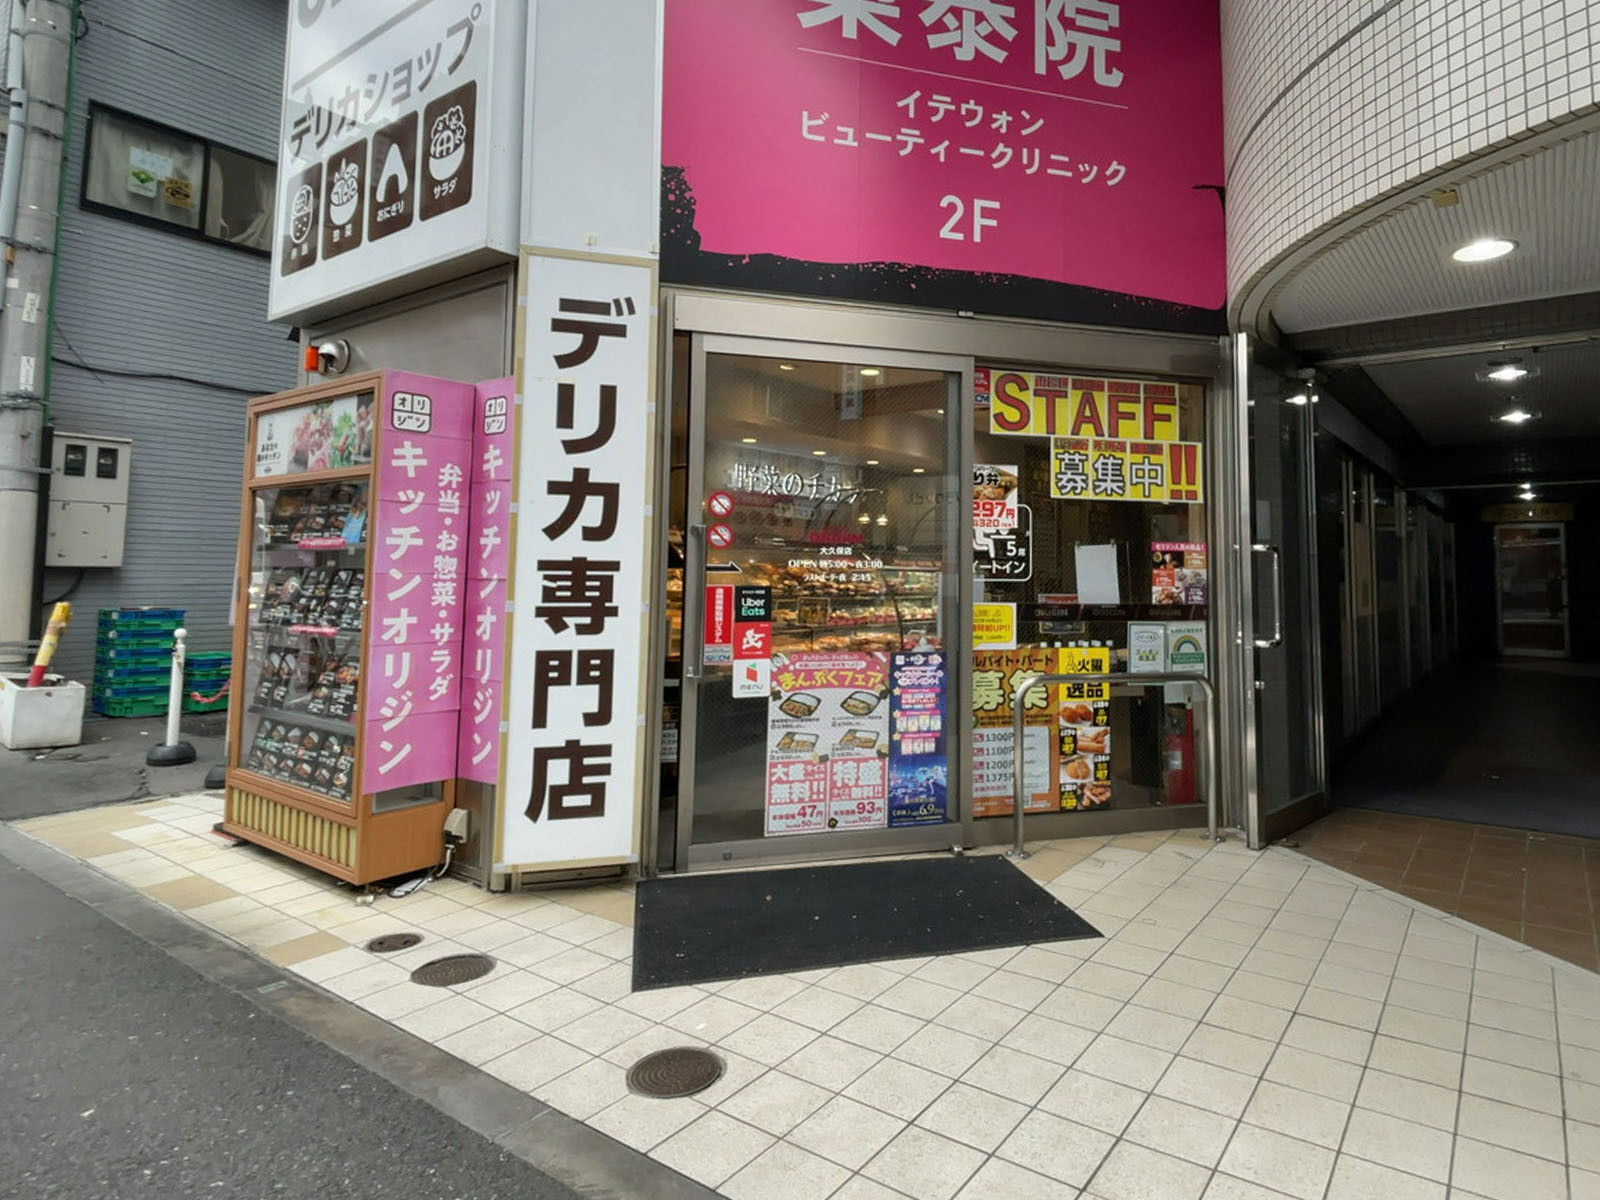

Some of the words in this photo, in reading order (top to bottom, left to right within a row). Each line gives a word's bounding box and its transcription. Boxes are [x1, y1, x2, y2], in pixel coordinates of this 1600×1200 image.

[290, 3, 482, 158] デリカショップ
[896, 90, 1045, 136] イテウォン
[801, 111, 1128, 187] ビューティークリニック
[377, 201, 405, 222] おにぎり
[433, 178, 459, 200] サラダ
[939, 194, 1001, 243] 2F
[993, 373, 1177, 440] STAFF
[524, 296, 636, 825] デリカ専門店
[378, 440, 428, 776] キッチンオリジン
[472, 444, 504, 766] キッチンオリジン
[741, 598, 765, 607] Uber
[741, 607, 765, 616] Eats
[778, 670, 883, 690] まんぷくフェア
